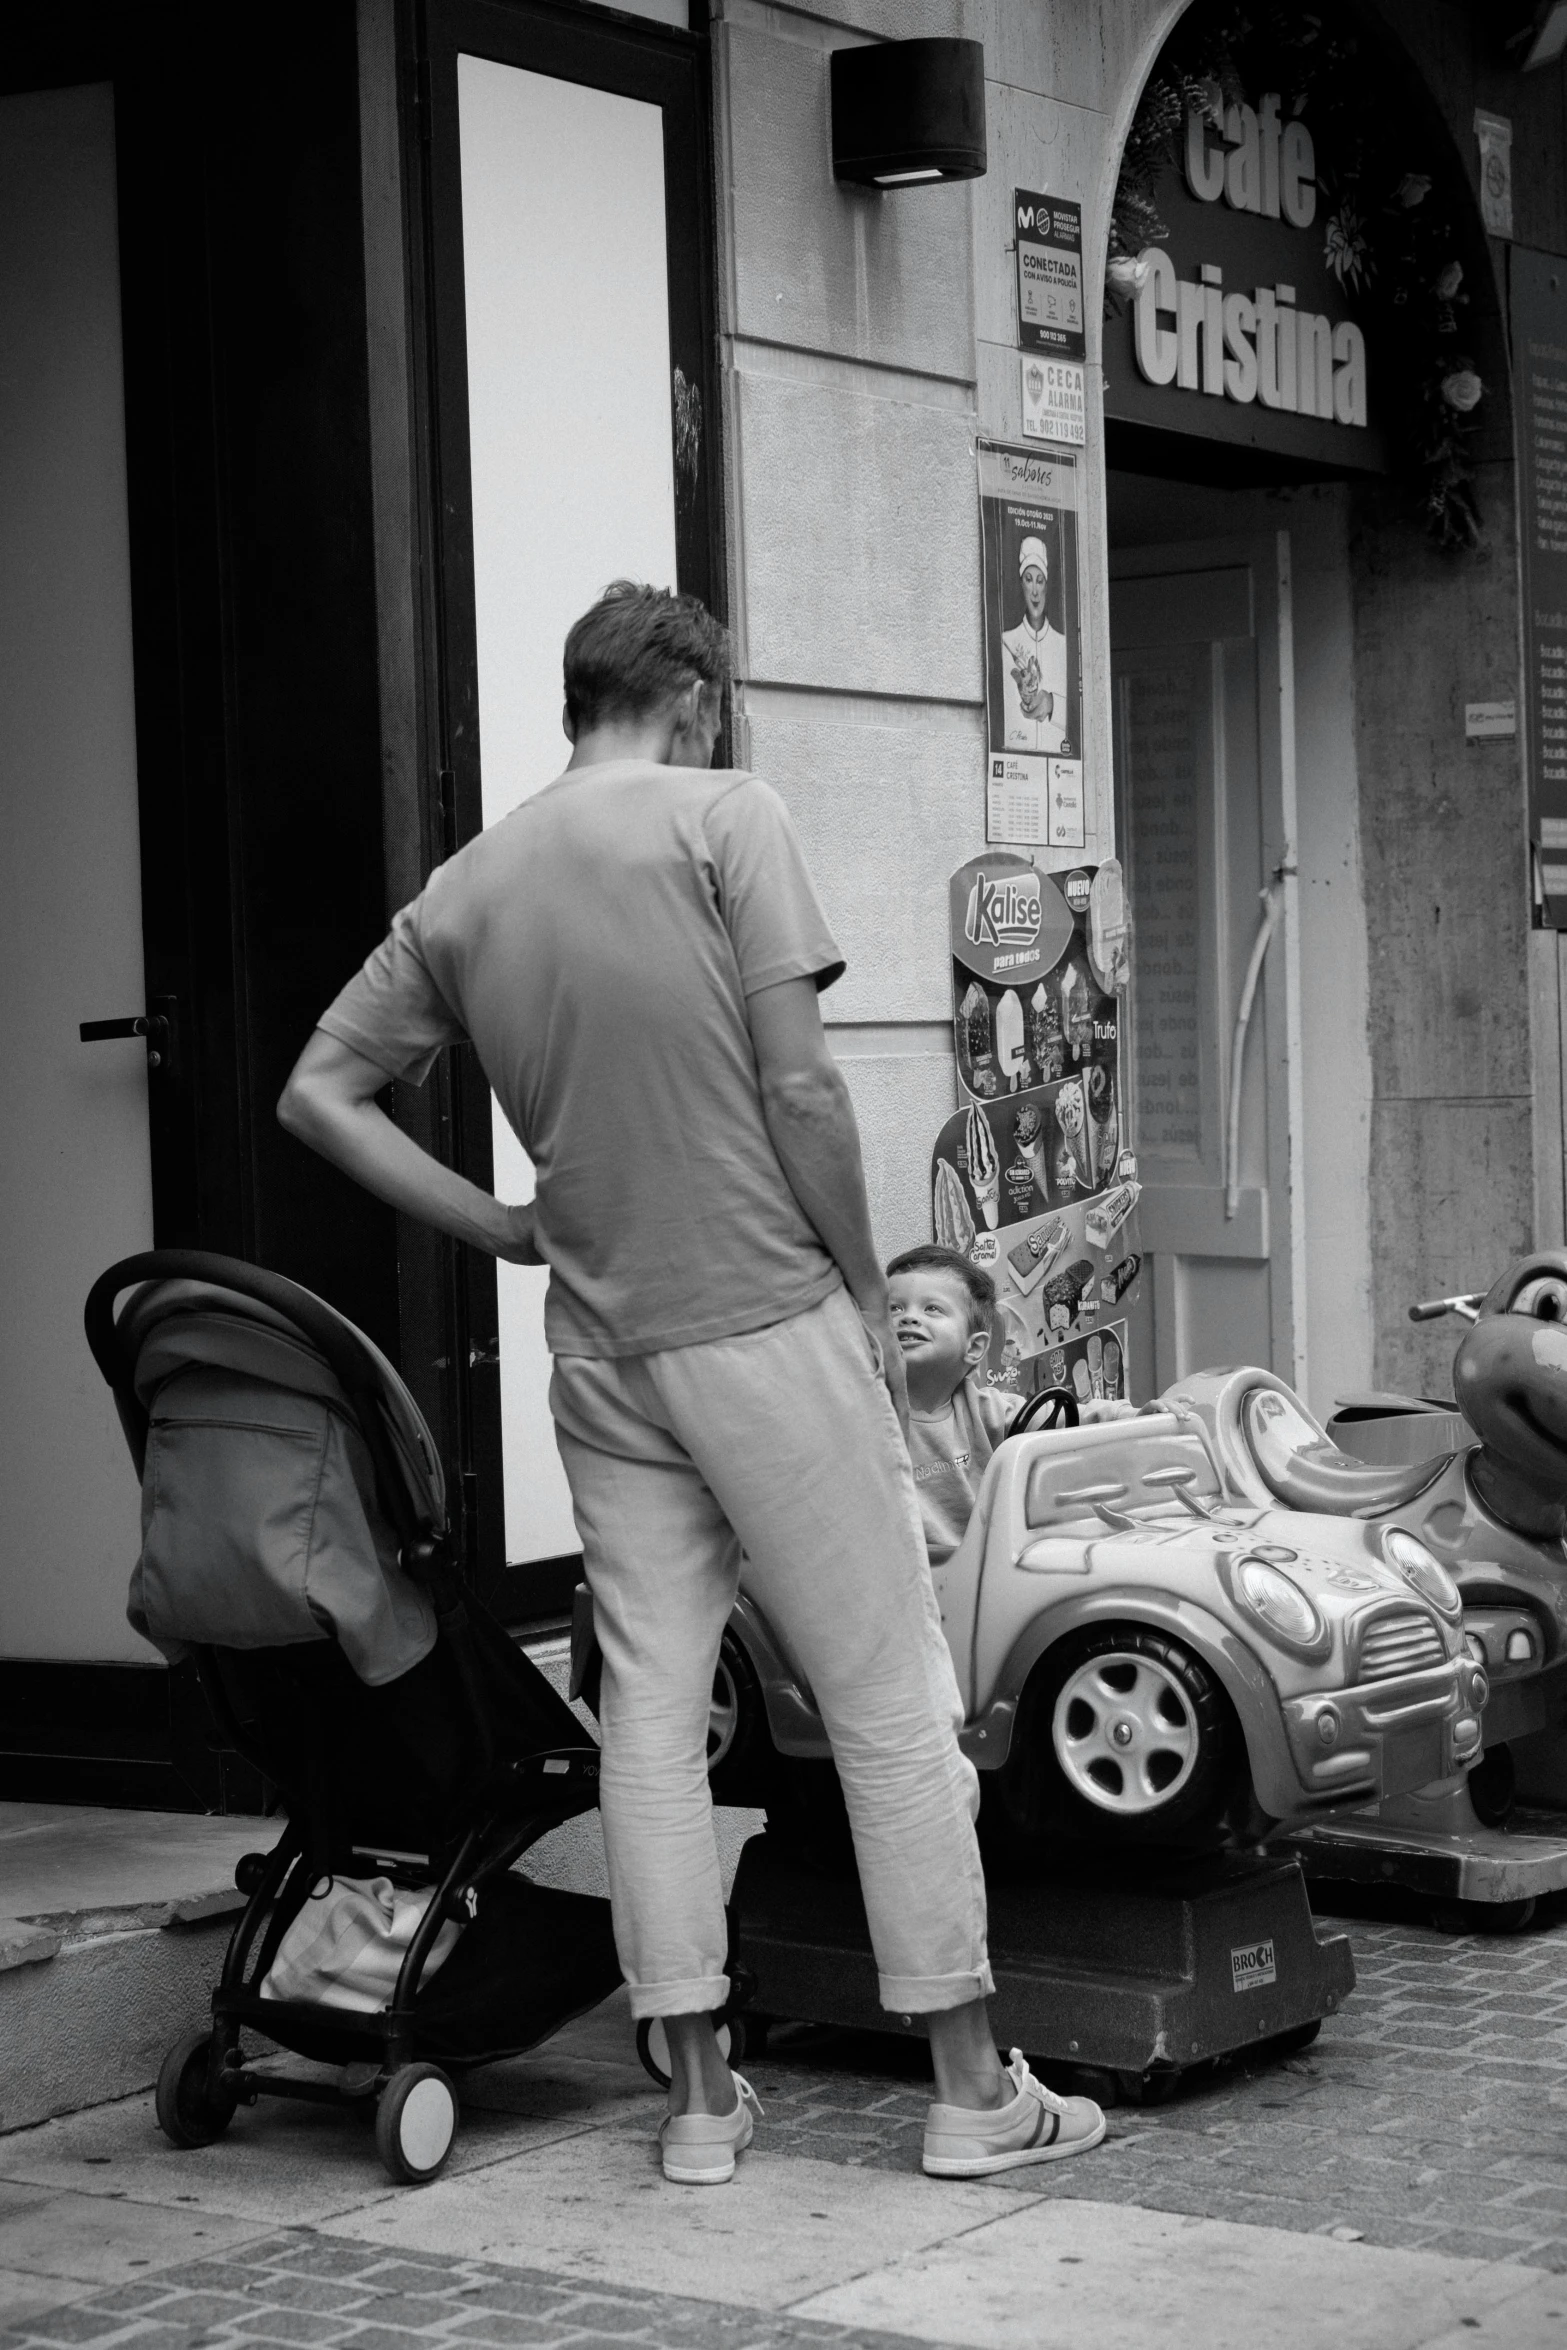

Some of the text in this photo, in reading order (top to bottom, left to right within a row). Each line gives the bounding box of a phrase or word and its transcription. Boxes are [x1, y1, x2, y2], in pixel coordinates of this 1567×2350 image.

[1185, 84, 1317, 228] Café
[1053, 211, 1078, 224] MOVISTAR
[1053, 221, 1080, 234] PROSEGUR
[1054, 230, 1075, 243] ALARMAS
[1023, 254, 1077, 278] CONECTADA
[1024, 270, 1077, 289] CON AVISO A POLICÍA
[1040, 329, 1049, 339] 900
[1134, 247, 1367, 427] Cristina
[1047, 366, 1082, 391] CECA
[1048, 390, 1083, 413] ALARMA
[1026, 418, 1084, 441] TEL. 902 119 492
[1011, 452, 1052, 487] sabores
[1008, 506, 1025, 517] EDICIÓN
[1026, 509, 1042, 519] OTOÑO
[994, 763, 1002, 776] 14
[1006, 760, 1018, 770] CAFÉ
[1006, 772, 1029, 781] CRISTINA
[1067, 880, 1090, 897] NUEVO
[973, 872, 1041, 946] Kalise
[994, 949, 1040, 970] para todos
[974, 1238, 996, 1252] Salted
[969, 1248, 997, 1264] Caramel
[1233, 1946, 1273, 1972] BROCH
